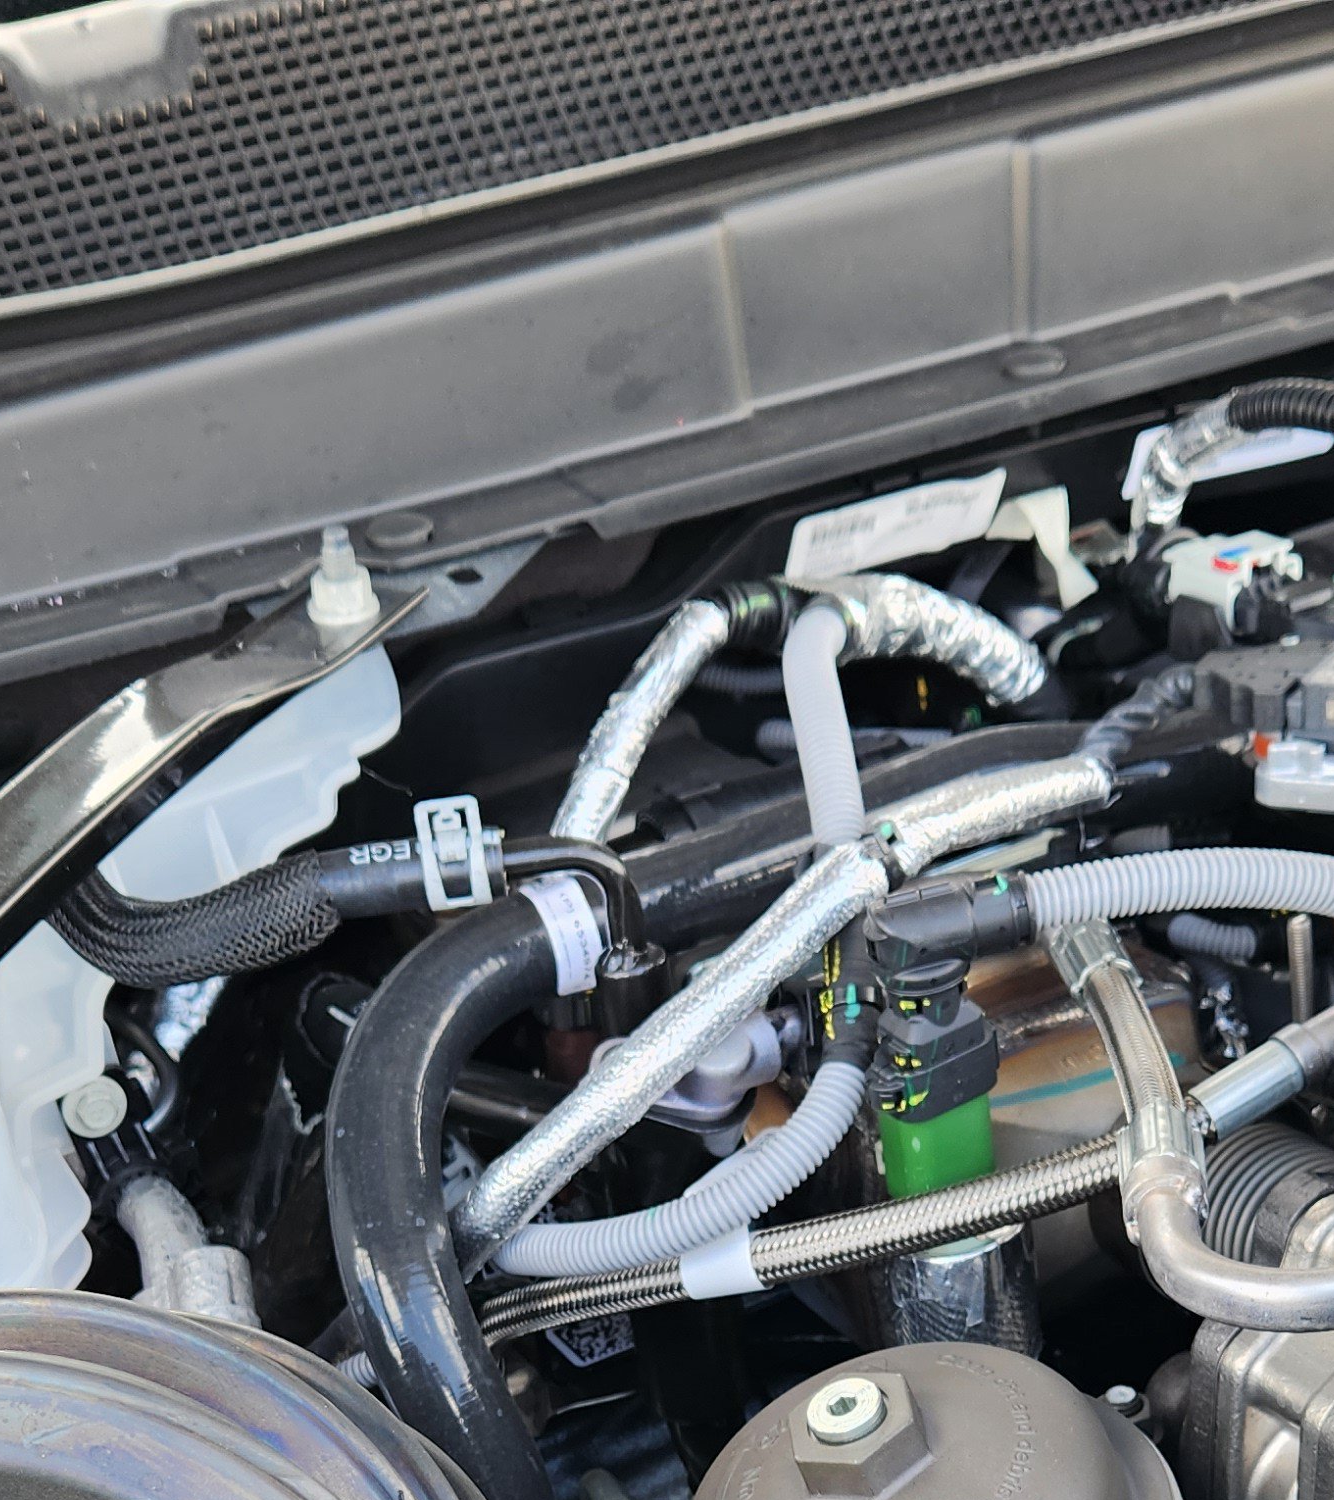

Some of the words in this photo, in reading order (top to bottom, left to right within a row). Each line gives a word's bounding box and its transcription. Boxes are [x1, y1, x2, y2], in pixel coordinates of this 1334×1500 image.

[348, 839, 411, 866] EGR
[1011, 1401, 1037, 1436] and
[995, 1438, 1038, 1500] debris
